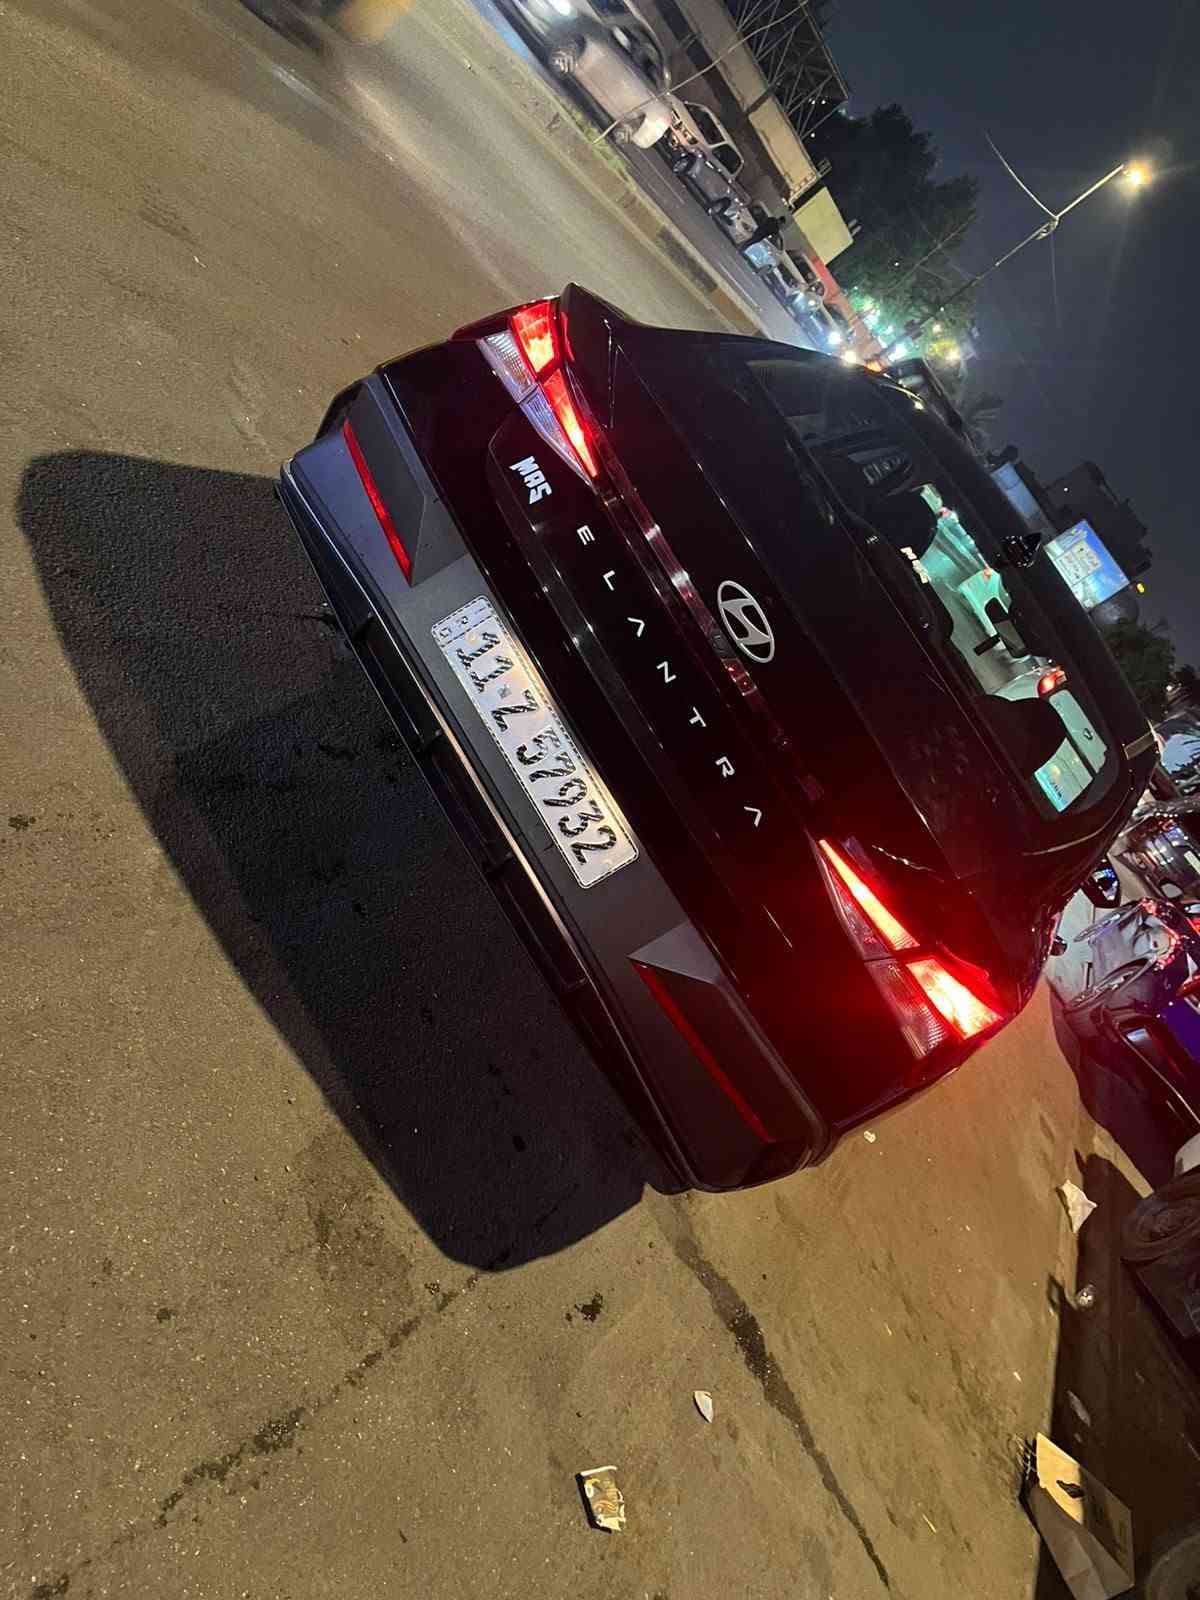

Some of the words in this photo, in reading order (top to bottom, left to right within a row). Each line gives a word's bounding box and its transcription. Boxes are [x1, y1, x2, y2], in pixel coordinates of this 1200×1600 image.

[509, 456, 553, 505] MAS
[456, 632, 514, 693] 11
[491, 690, 539, 733] Z
[516, 728, 617, 866] 57932
[577, 525, 762, 828] ELANTRA
